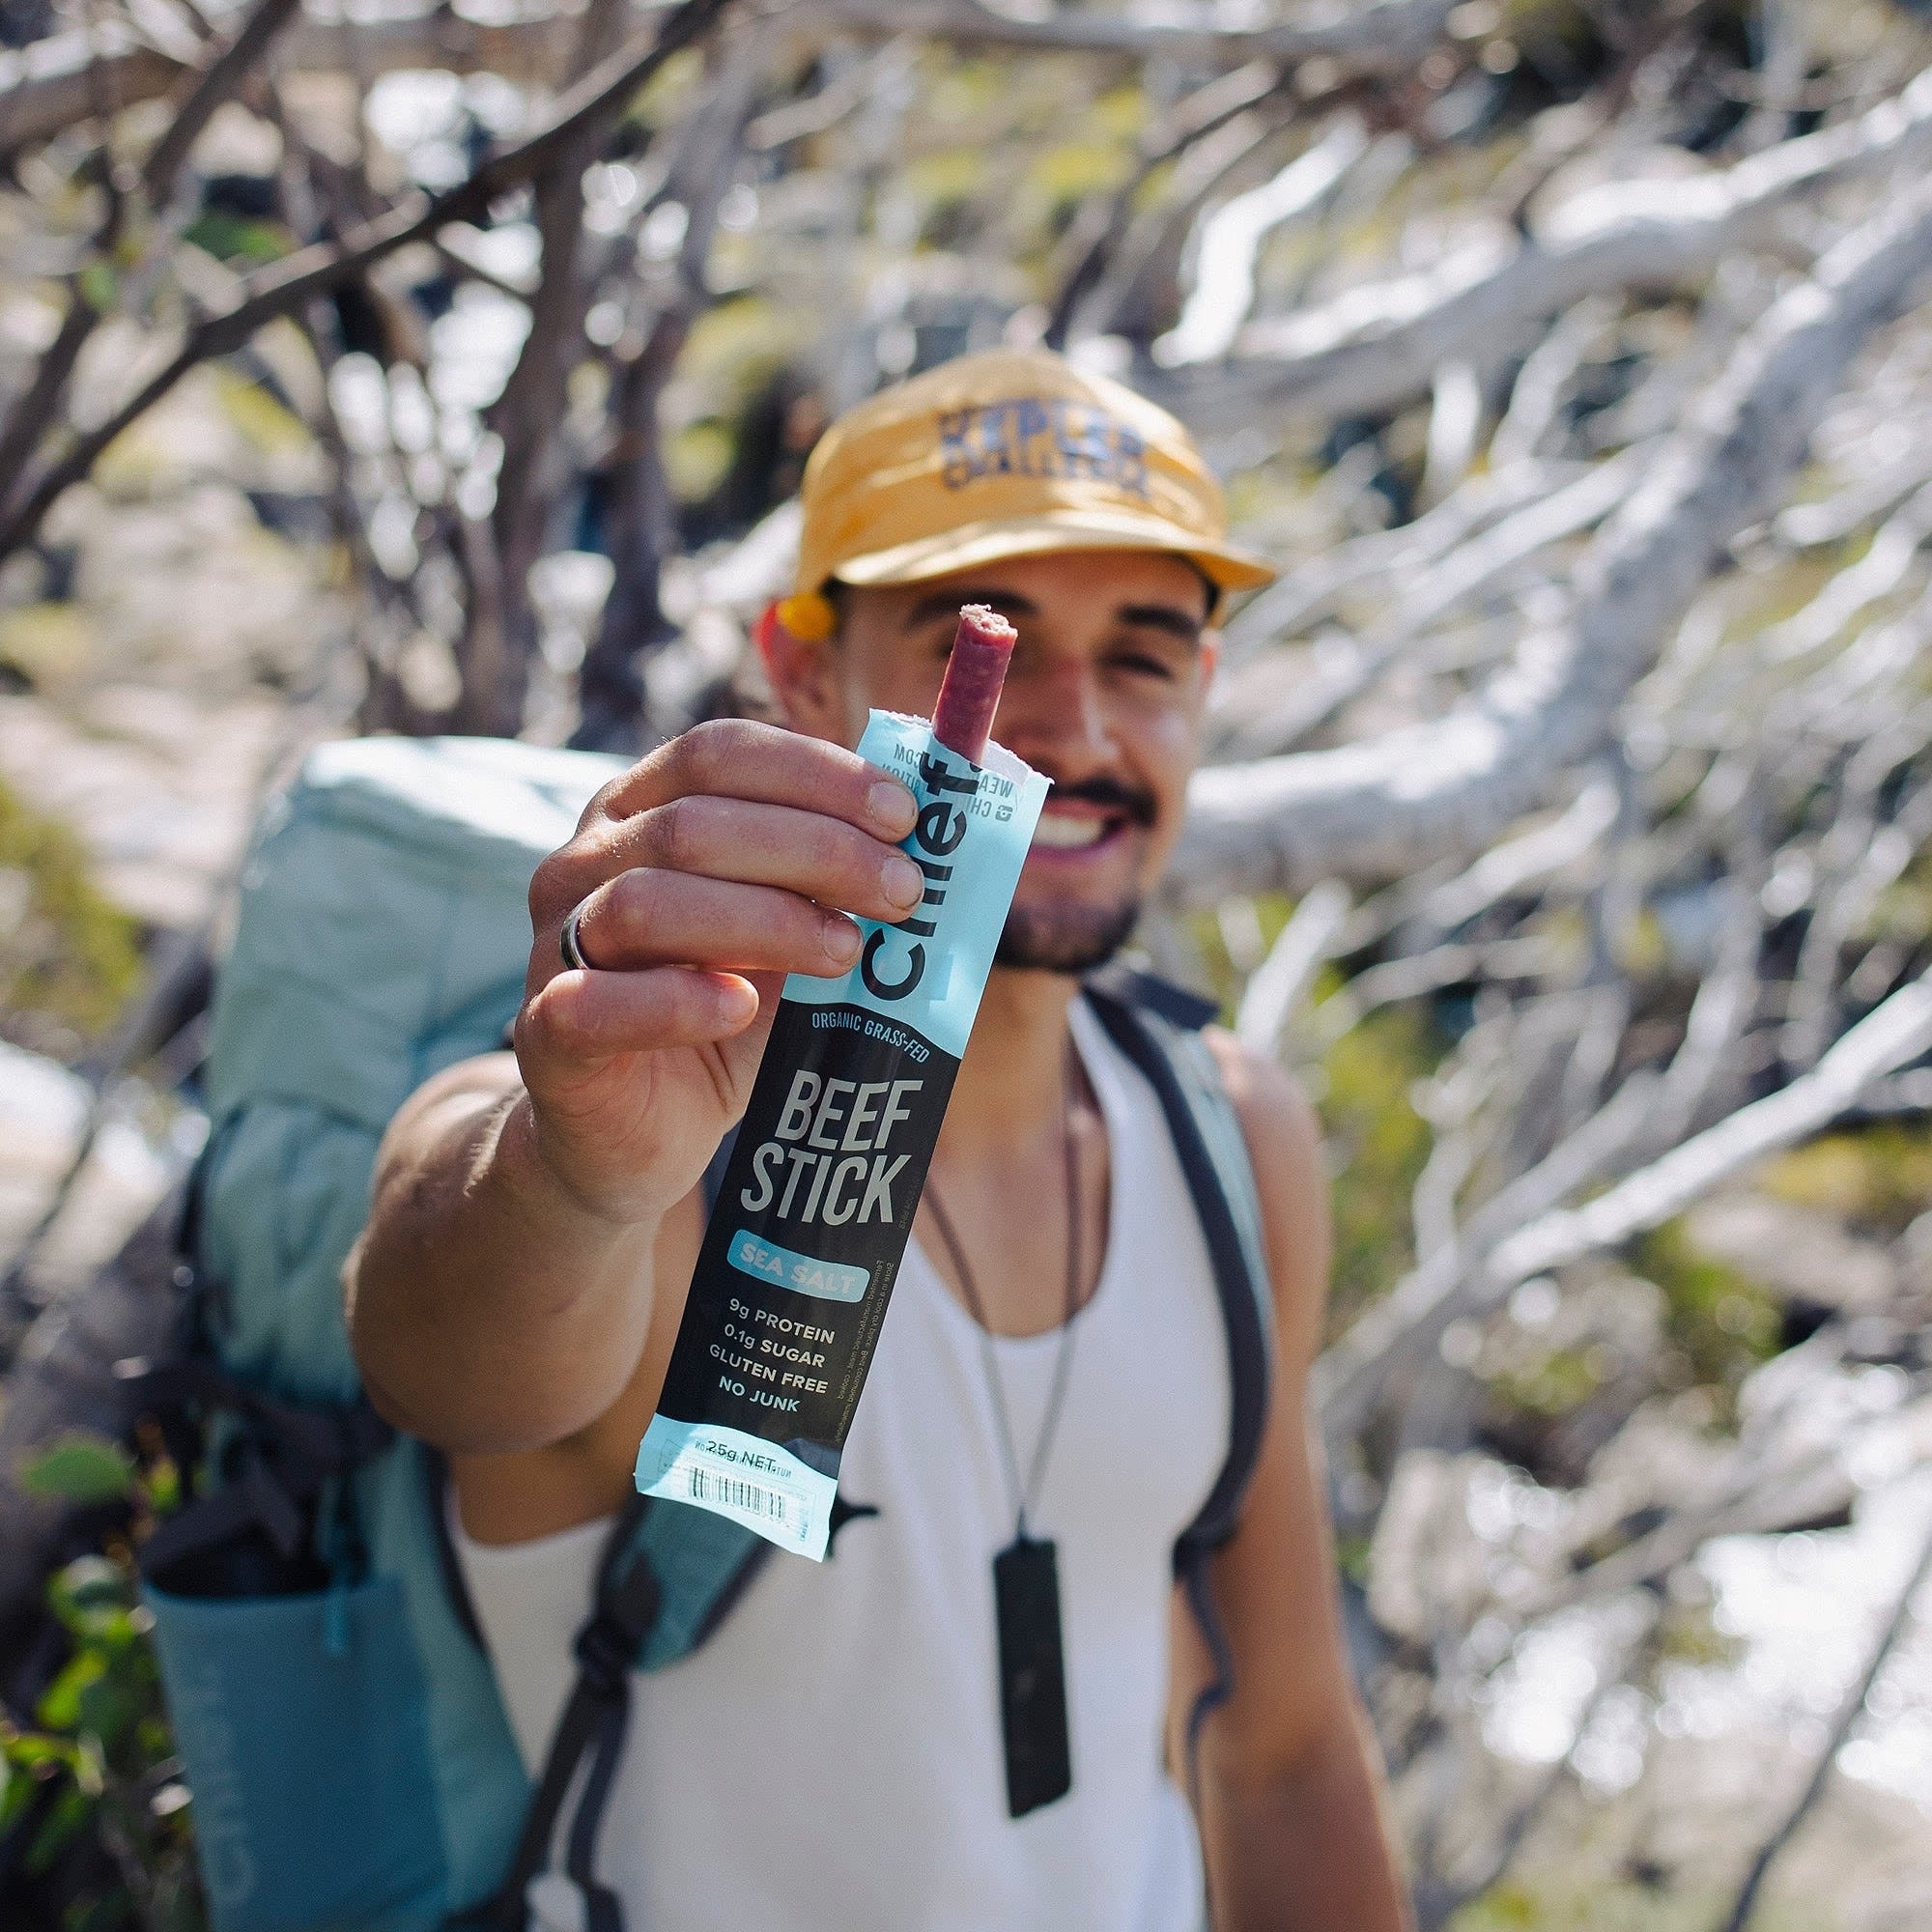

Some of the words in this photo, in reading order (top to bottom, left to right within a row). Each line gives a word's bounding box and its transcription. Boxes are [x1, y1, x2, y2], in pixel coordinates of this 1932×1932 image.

[811, 1011, 861, 1031] ORGANIC
[865, 1020, 930, 1064] GRASS-FED
[774, 1069, 923, 1151] BEEF
[740, 1142, 912, 1226] STICK
[740, 1242, 783, 1276] SEA
[790, 1264, 857, 1293] SALT
[724, 1323, 755, 1350] 0.1g
[760, 1339, 826, 1368] SUGAR
[729, 1297, 750, 1320] 9g
[754, 1309, 836, 1345] PROTEIN
[709, 1344, 777, 1381] GLUTEN
[781, 1372, 829, 1394] FREE
[719, 1376, 746, 1396] NO
[749, 1390, 801, 1412] JUNK
[707, 1440, 737, 1463] 25g
